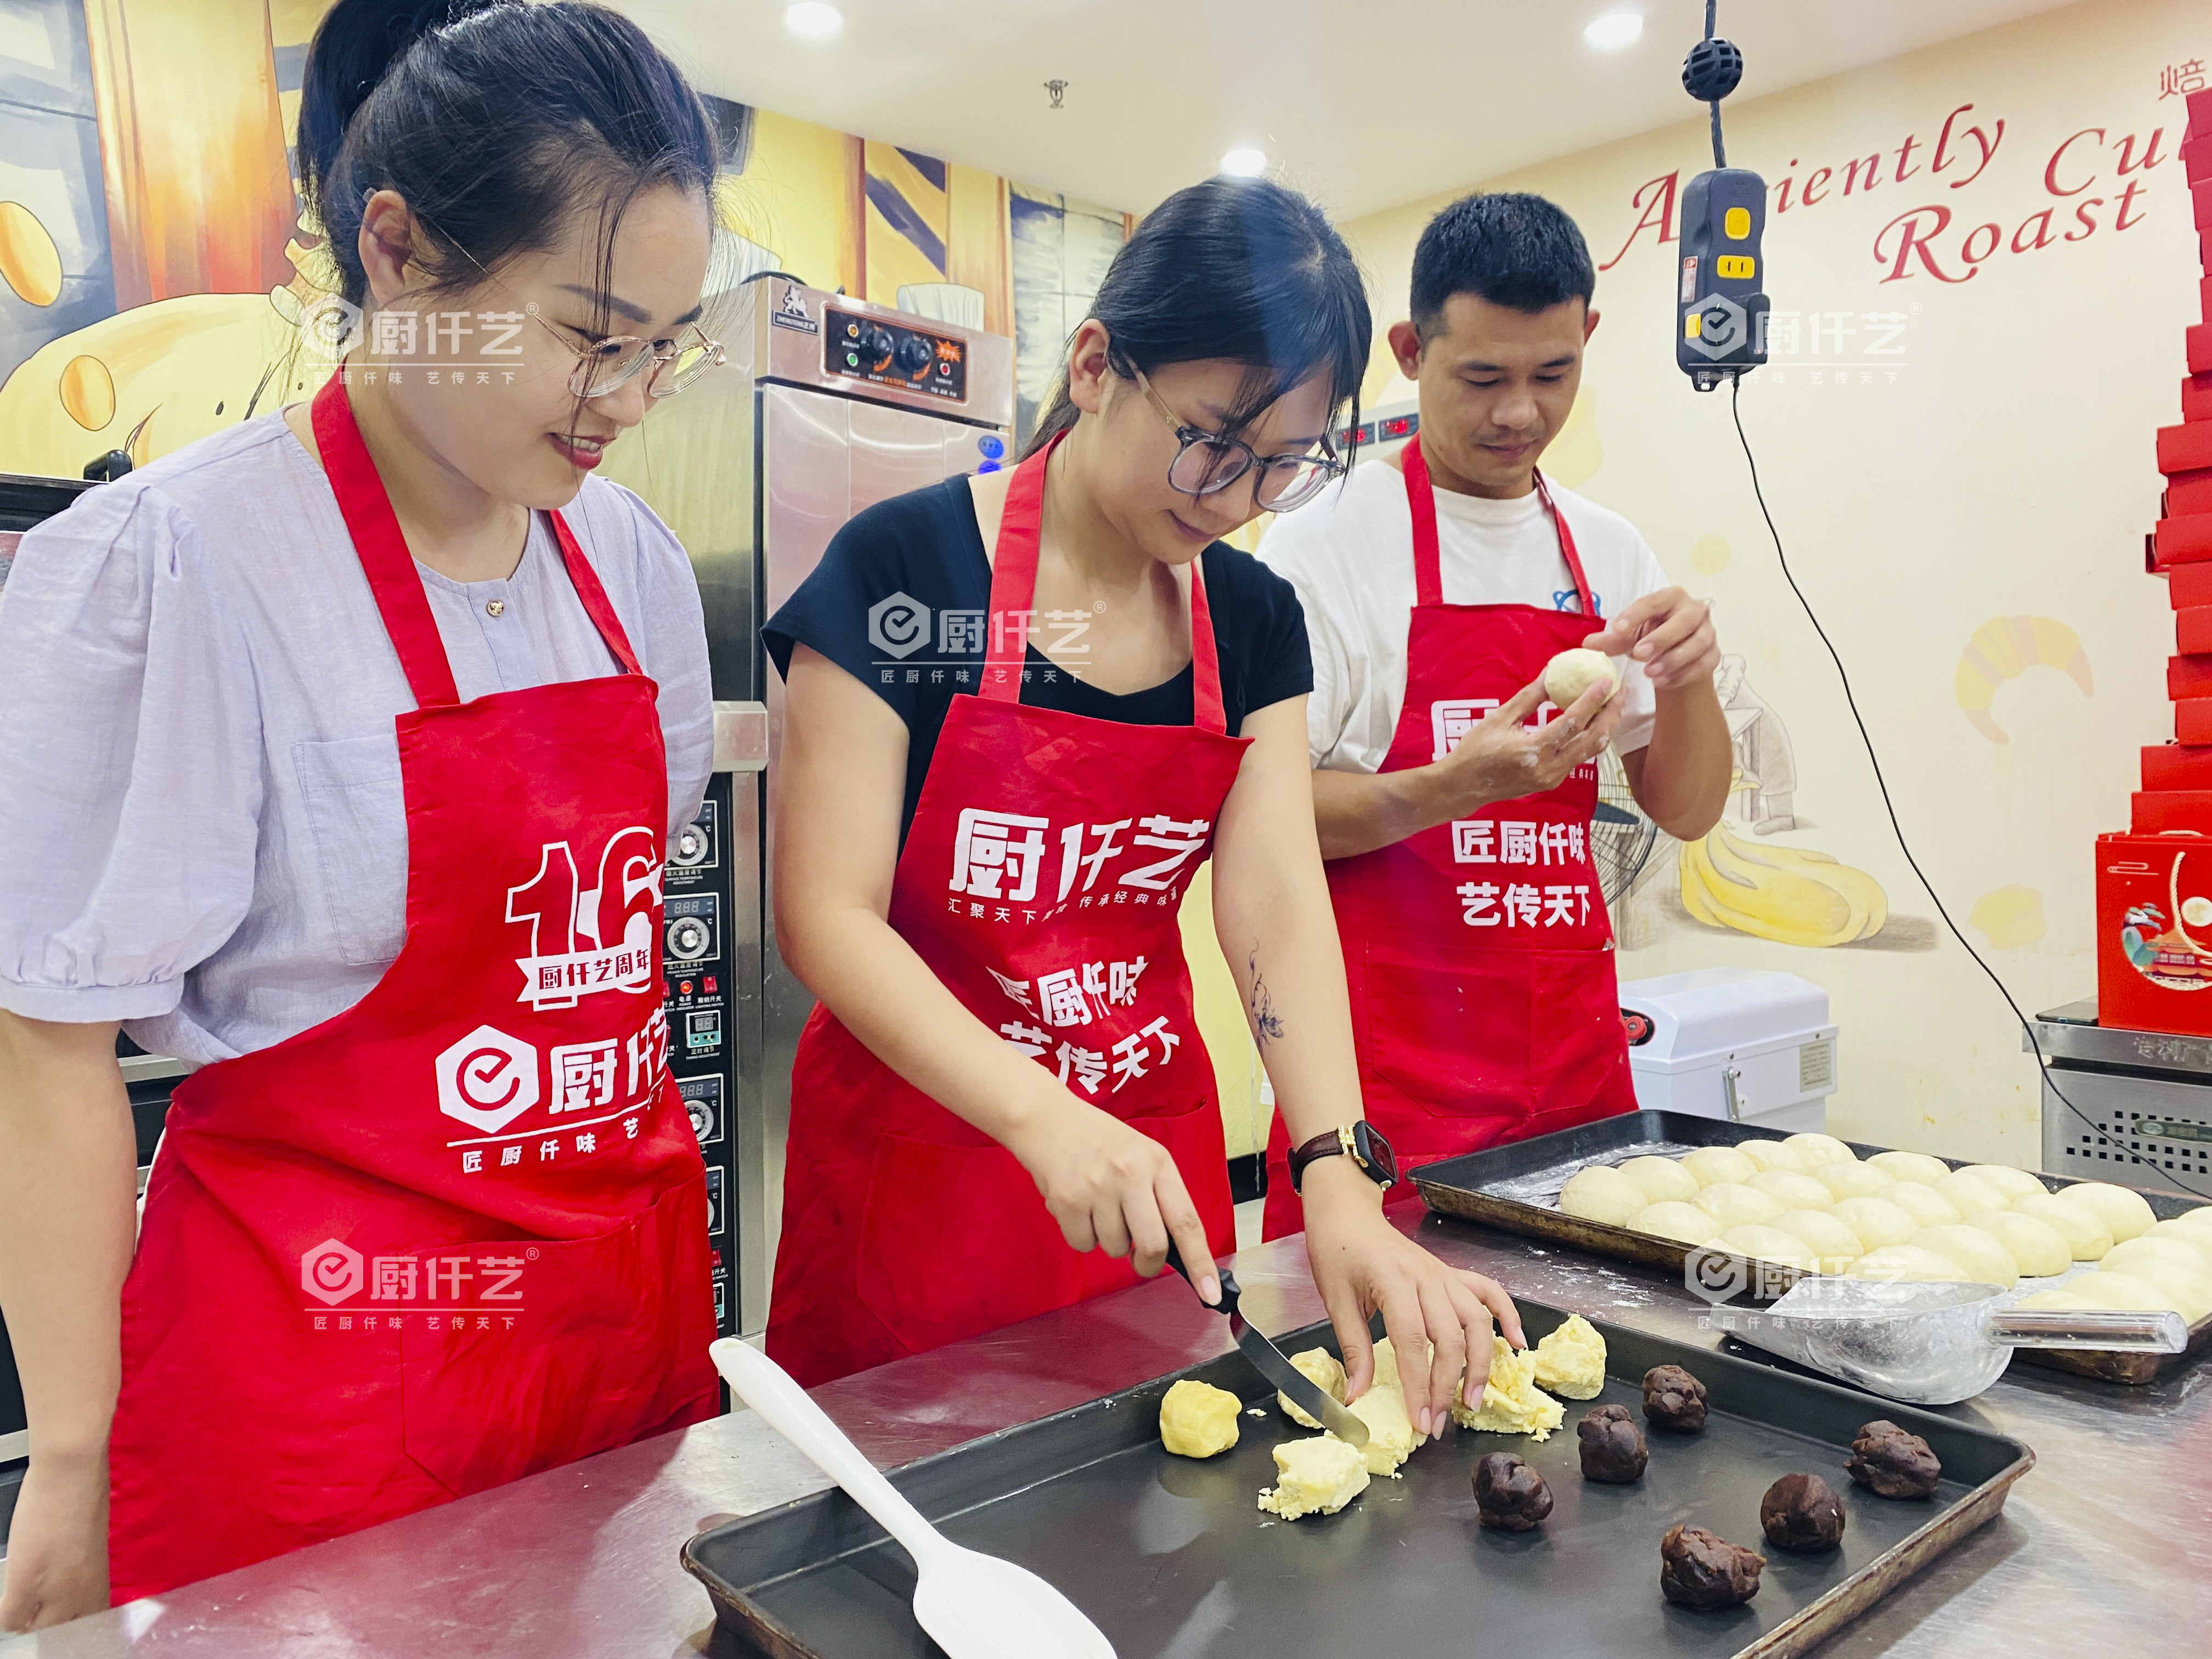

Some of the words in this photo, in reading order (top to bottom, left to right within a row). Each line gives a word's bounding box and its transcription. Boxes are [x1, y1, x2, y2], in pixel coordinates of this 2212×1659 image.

[2159, 58, 2207, 100] 焙
[1599, 103, 2005, 271] Aiently
[1874, 178, 2147, 284] Roast
[949, 808, 1209, 903] 厨仟艺
[1451, 820, 1585, 866] 匠厨仟味
[948, 898, 1067, 926] 汇聚天下
[1457, 881, 1590, 928] 艺传天下
[539, 949, 649, 990] 厨仟艺周年
[697, 996, 722, 1004] 照明开关
[462, 1132, 596, 1173] 匠厨仟味
